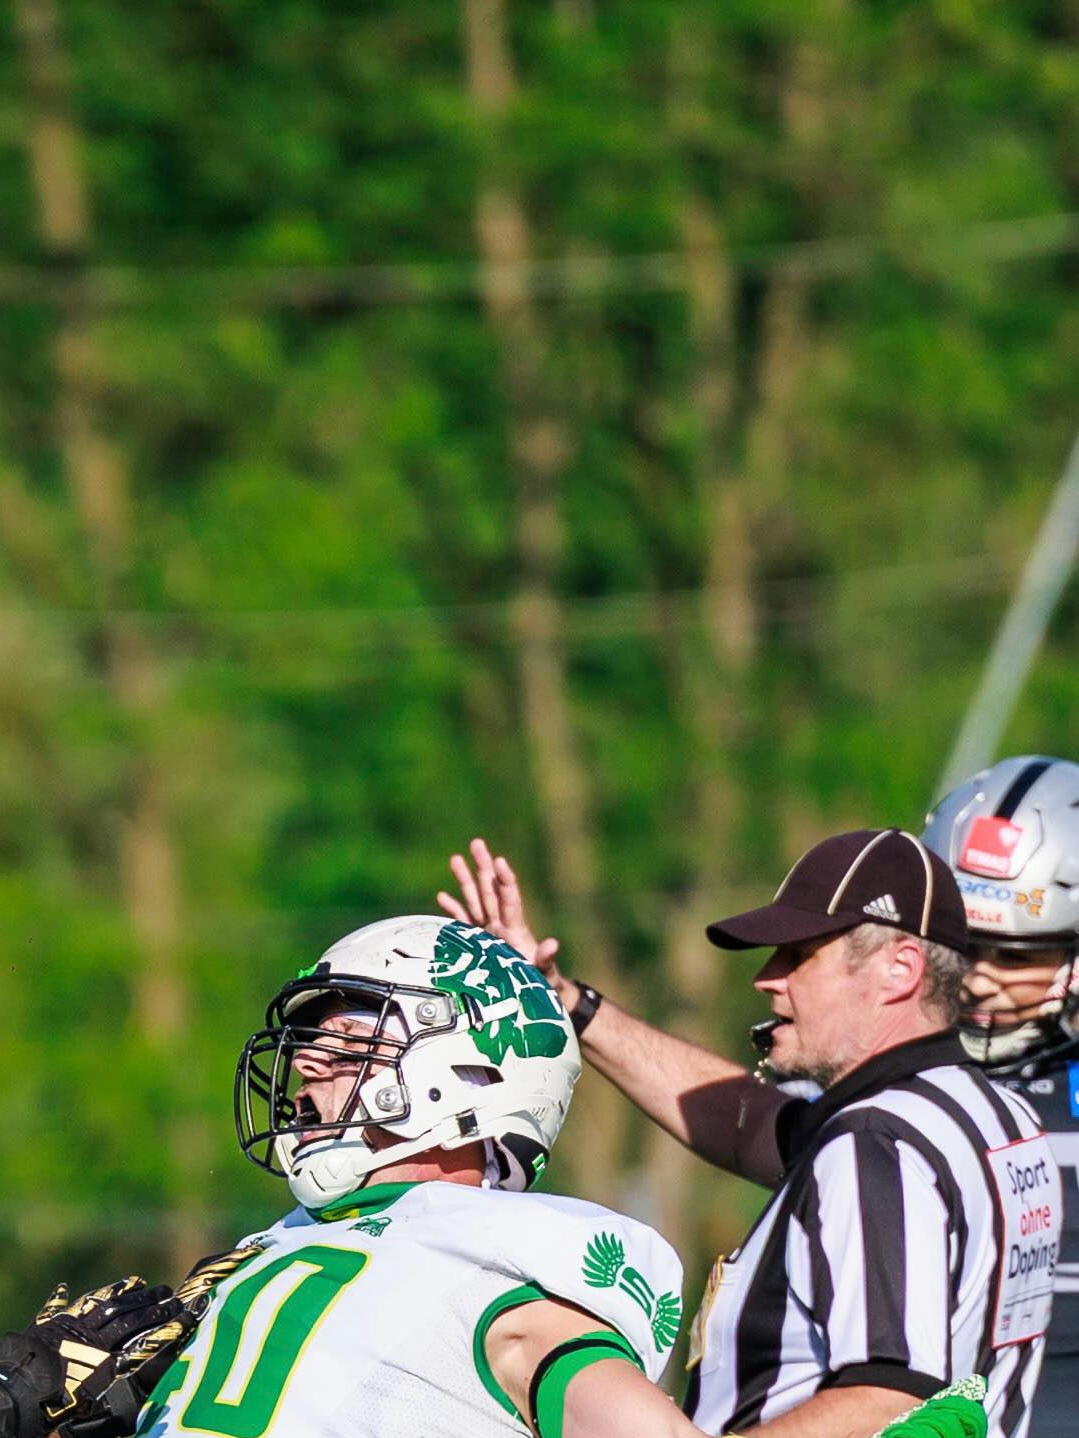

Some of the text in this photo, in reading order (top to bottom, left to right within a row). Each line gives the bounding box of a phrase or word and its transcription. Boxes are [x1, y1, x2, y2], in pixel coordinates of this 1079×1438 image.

[1006, 1157, 1050, 1203] Sport
[1020, 1199, 1052, 1237] ohne
[1008, 1238, 1058, 1283] Doping
